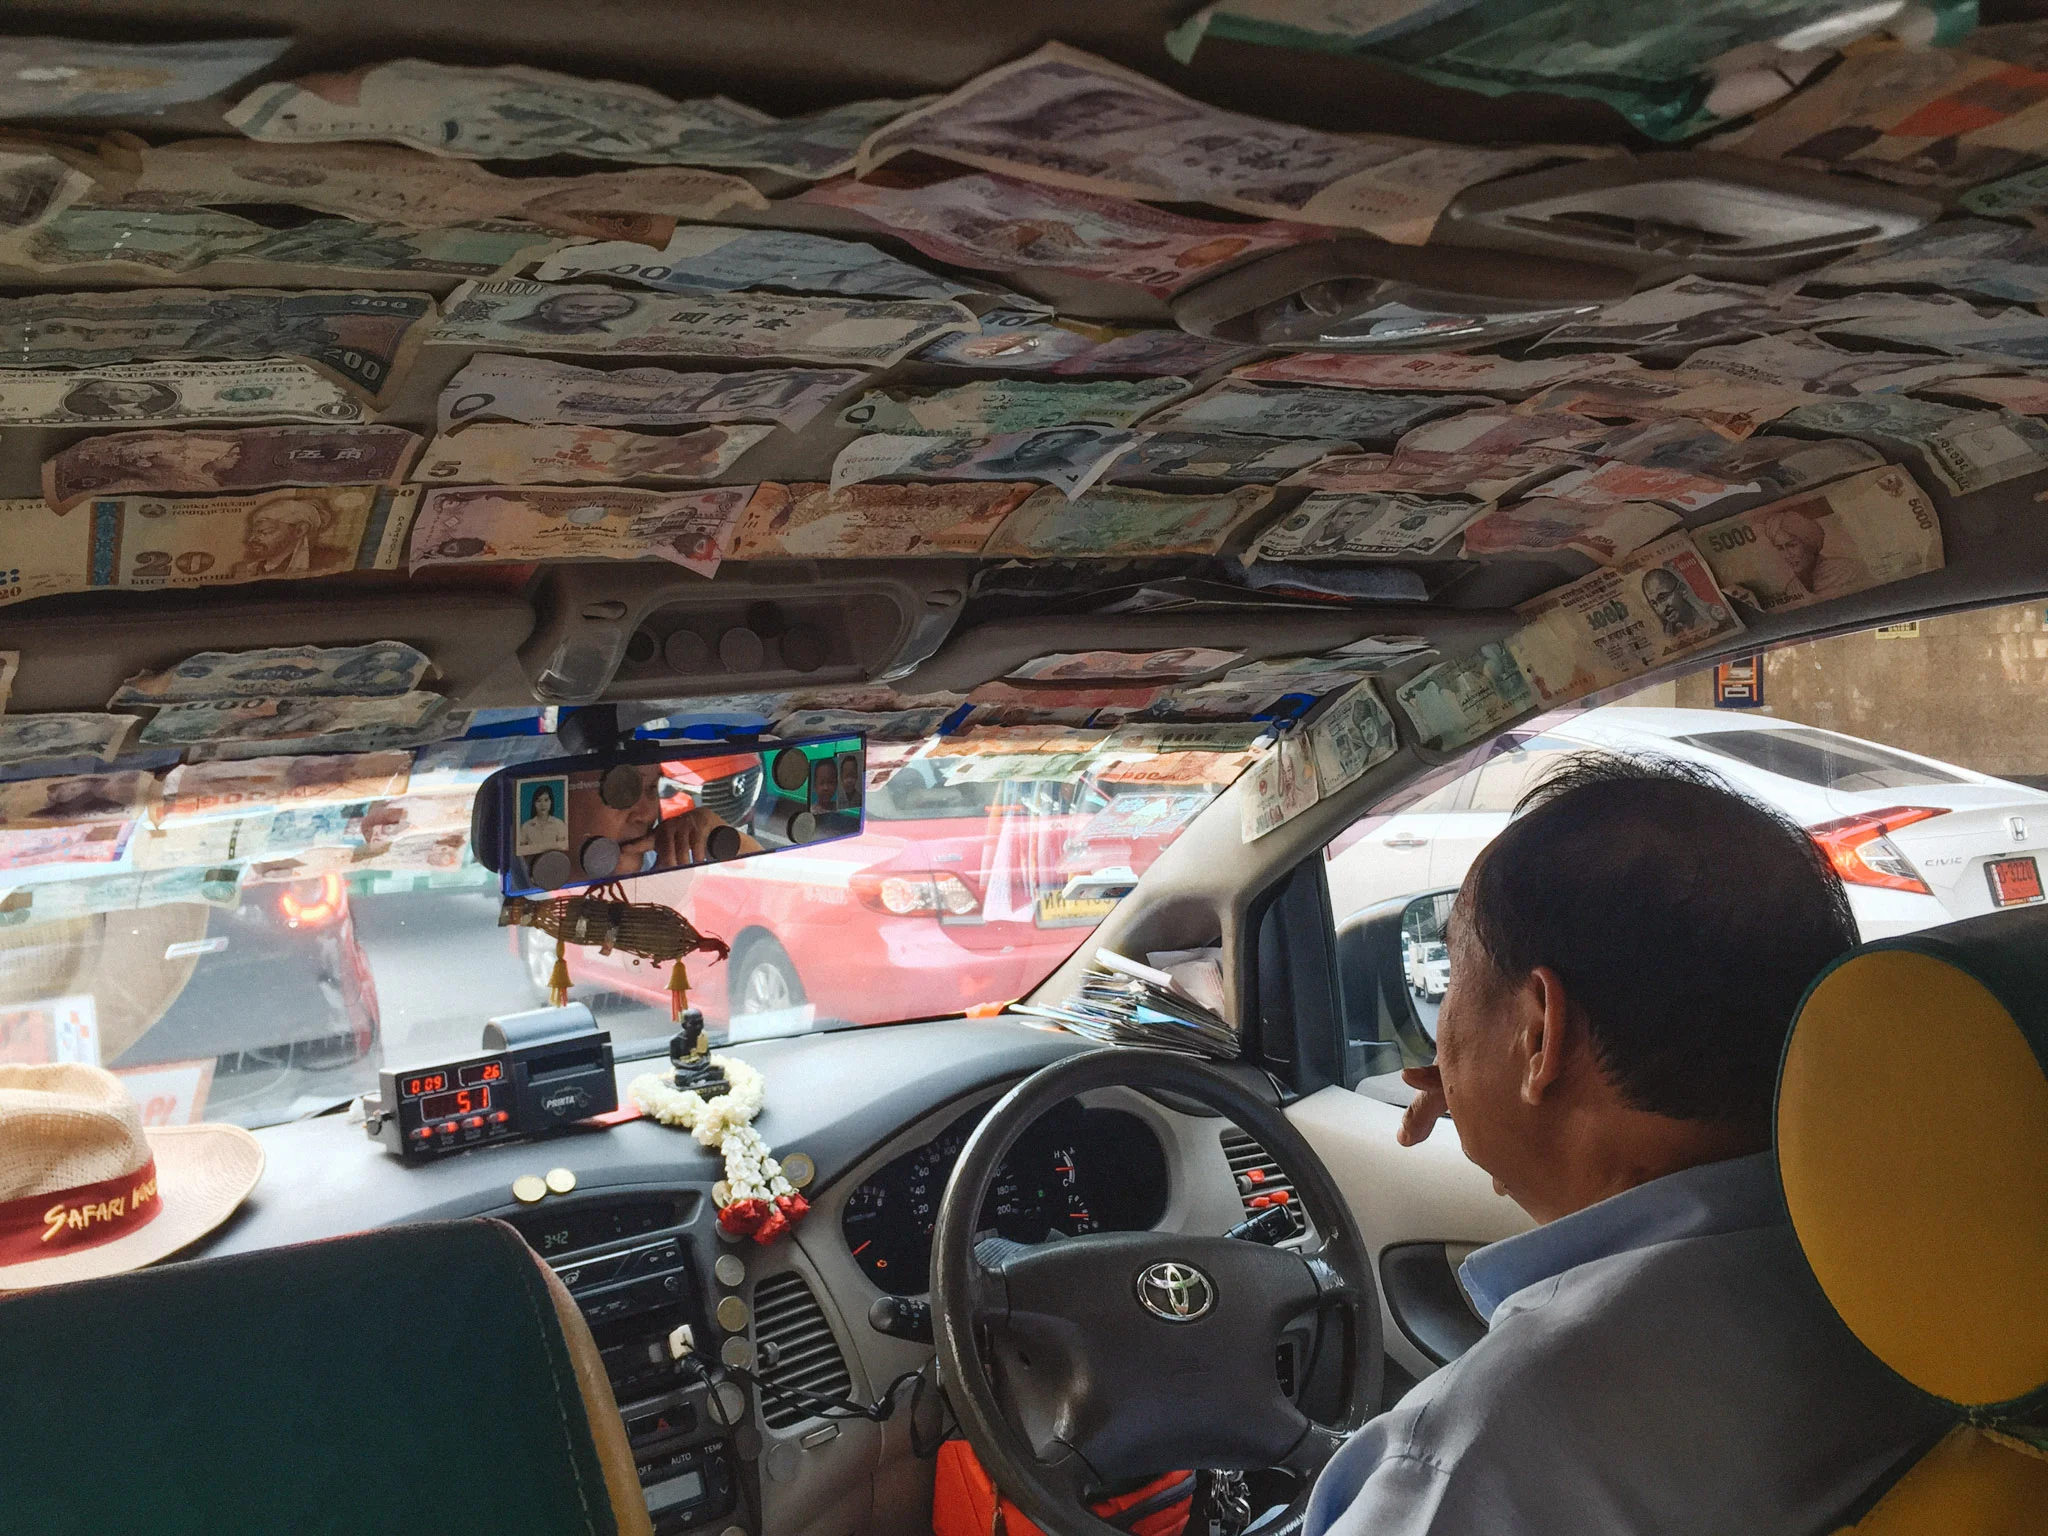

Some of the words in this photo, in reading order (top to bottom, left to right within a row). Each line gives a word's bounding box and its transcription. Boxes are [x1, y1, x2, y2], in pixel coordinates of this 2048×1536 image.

[324, 346, 381, 381] 200
[428, 461, 461, 477] 5
[1907, 498, 1932, 531] 5000
[1708, 525, 1757, 553] 5000
[132, 551, 215, 577] 20
[1925, 857, 1962, 867] CIVIC
[919, 1167, 930, 1177] 60
[915, 1185, 926, 1196] 40
[918, 1203, 929, 1215] 20
[997, 1203, 1011, 1215] 200
[40, 1196, 125, 1242] SAFARI
[704, 1441, 724, 1454] TEMP
[671, 1452, 692, 1465] AUTO
[638, 1463, 653, 1476] OFF
